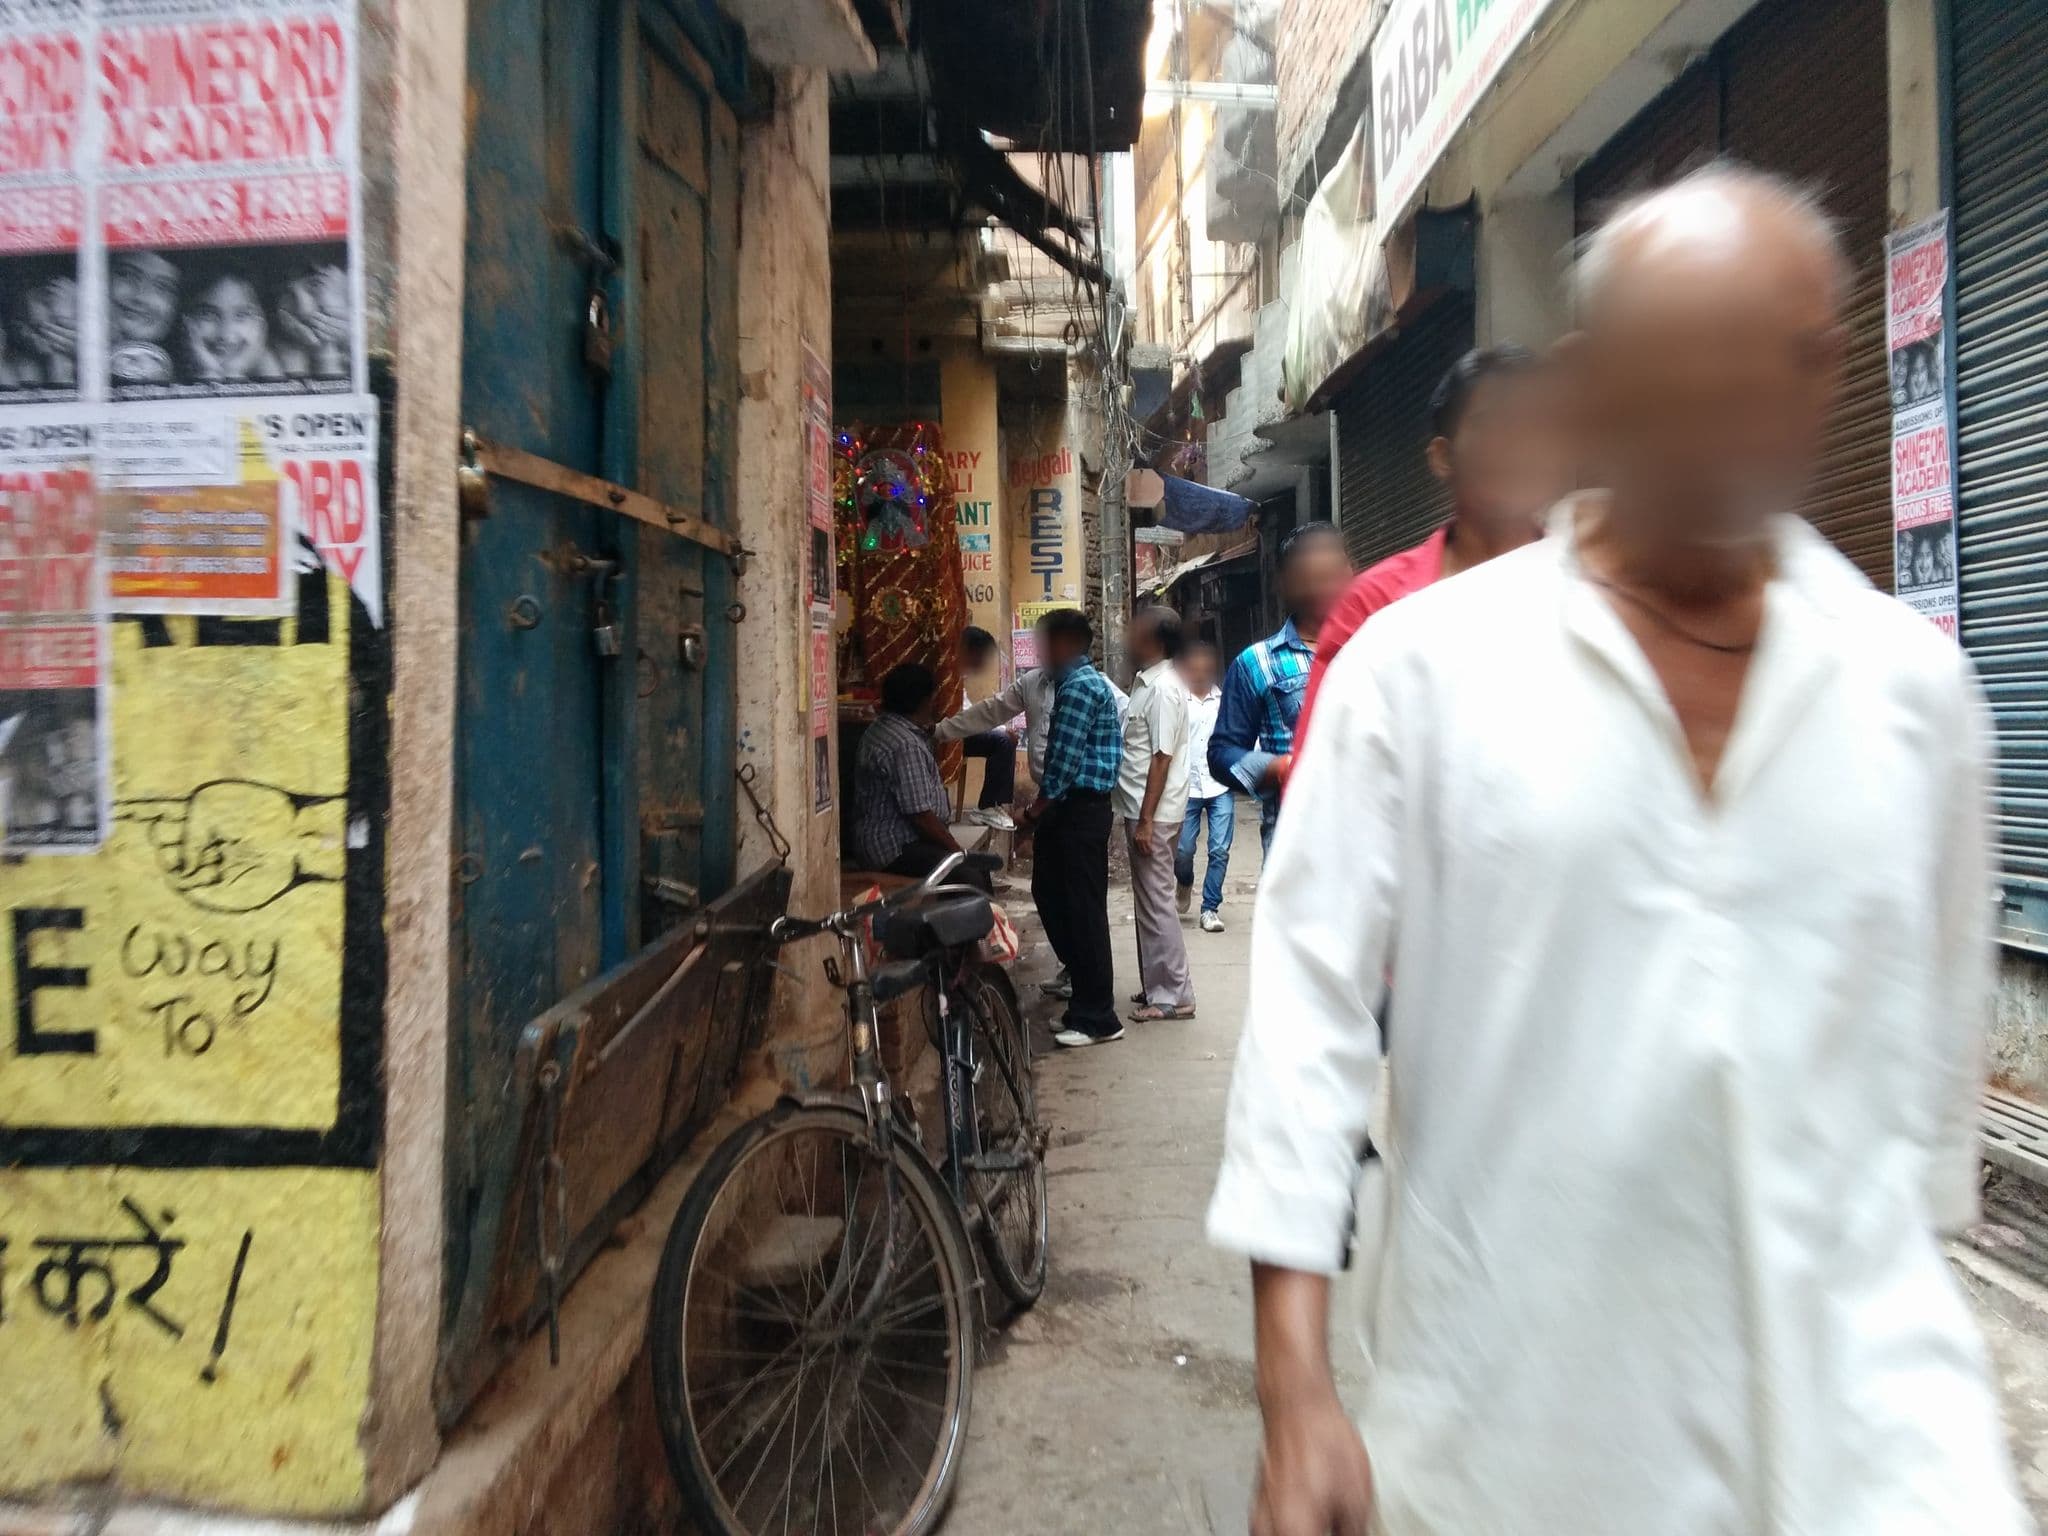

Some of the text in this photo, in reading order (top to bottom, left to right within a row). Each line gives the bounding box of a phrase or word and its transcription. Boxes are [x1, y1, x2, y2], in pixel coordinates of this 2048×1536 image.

[101, 16, 345, 106] SHINEFORD
[1380, 0, 1453, 182] BABA
[102, 97, 338, 167] ACADEMY
[289, 410, 366, 439] OPEN
[1010, 447, 1072, 488] Bengali
[1897, 463, 1950, 497] ACADEMY
